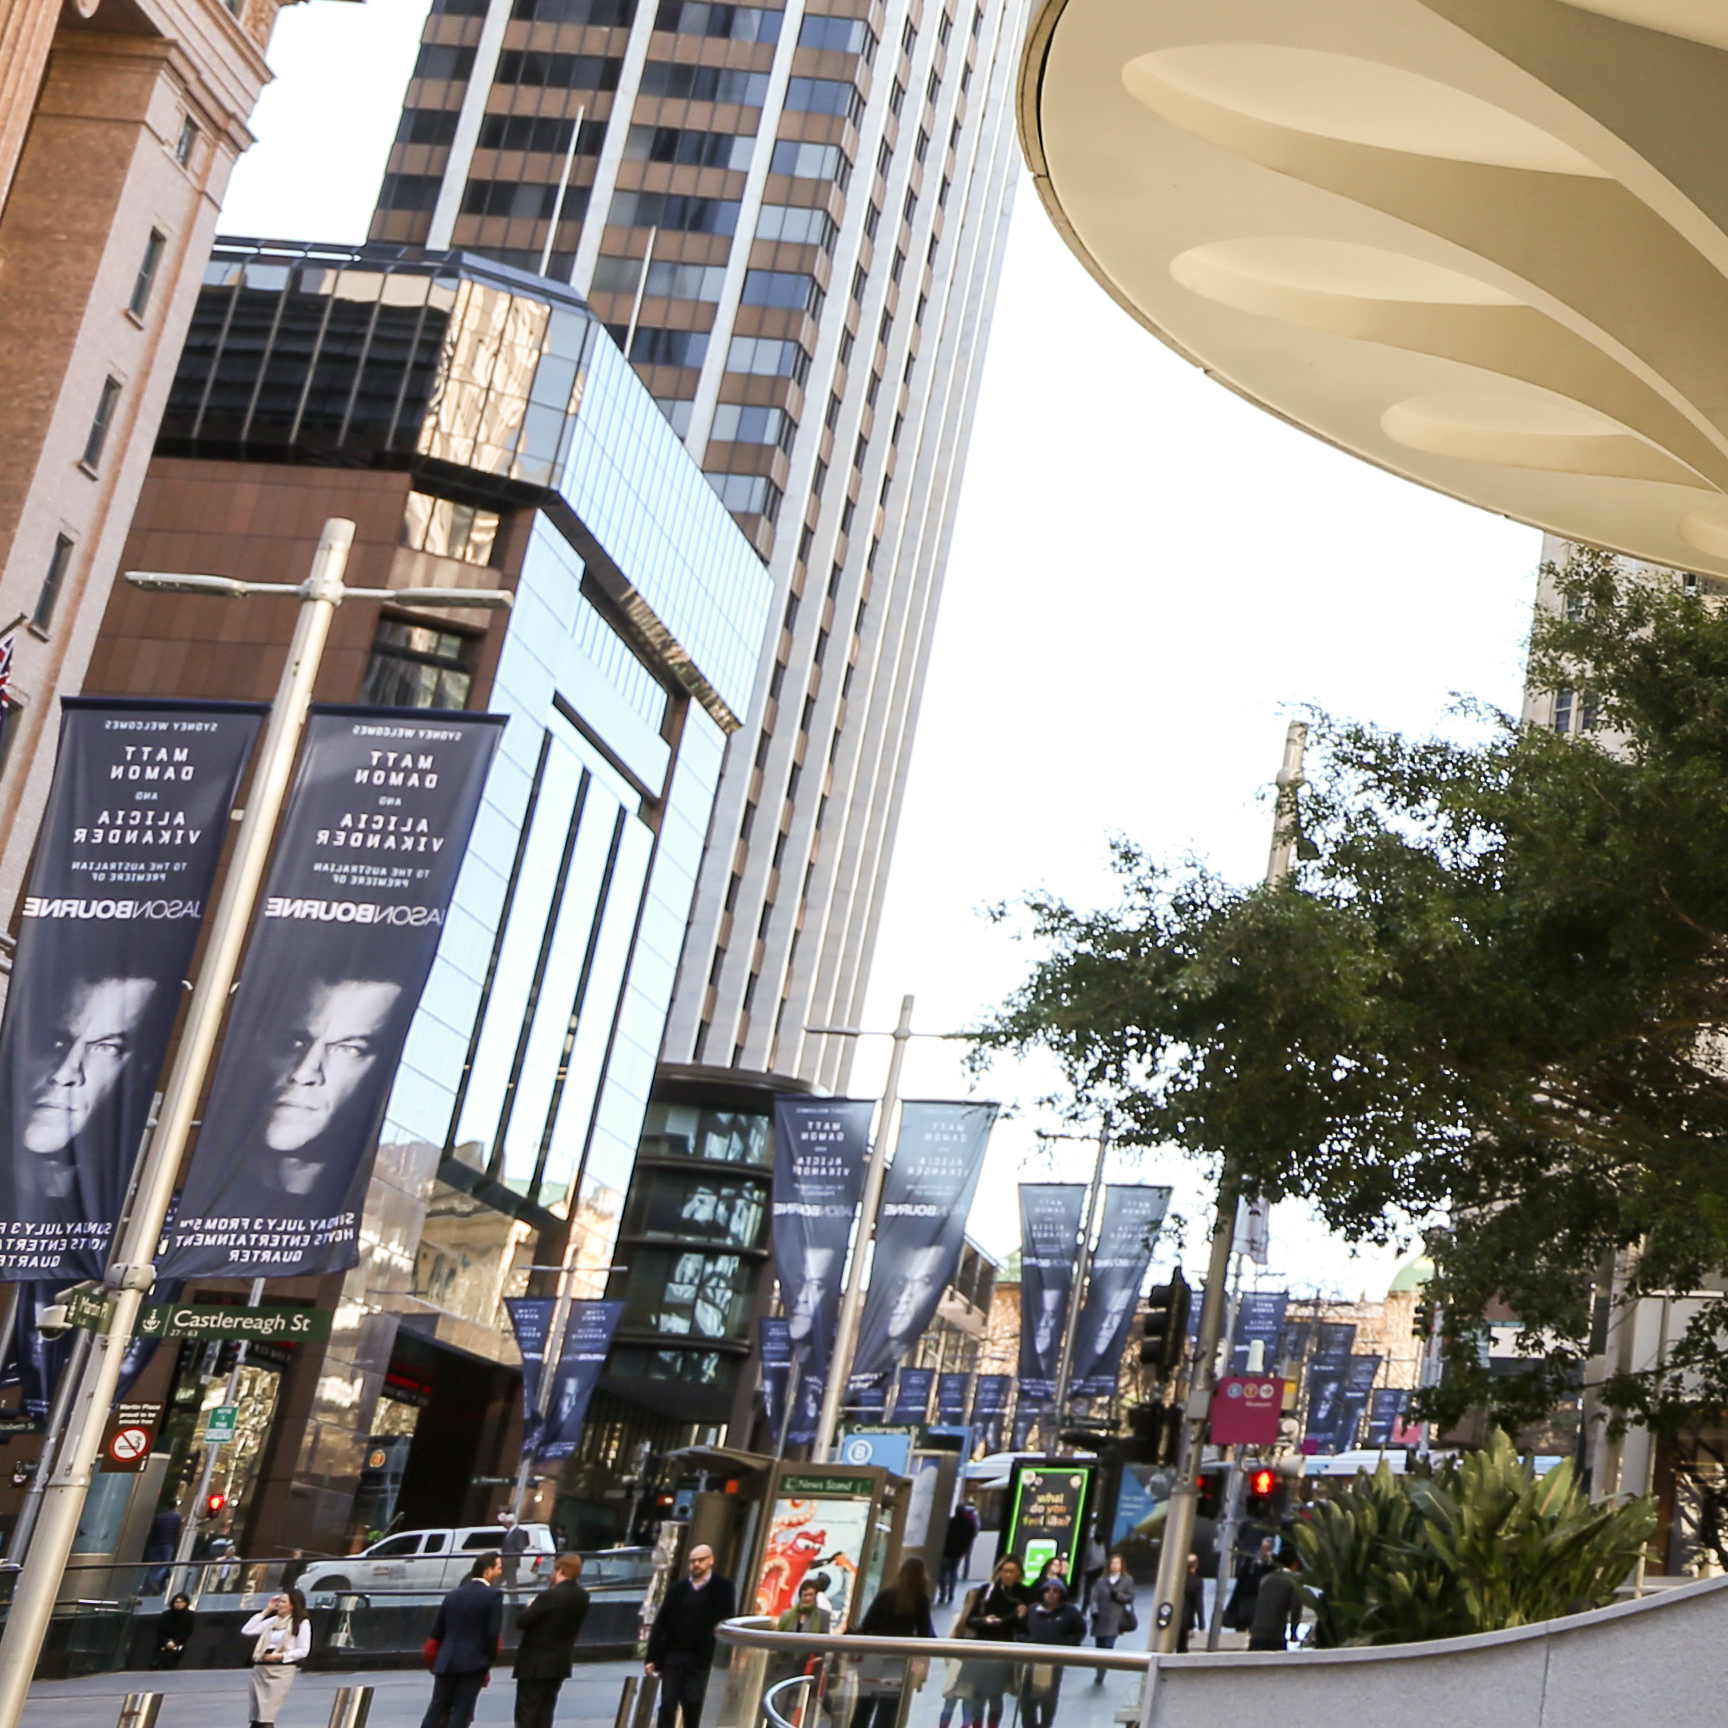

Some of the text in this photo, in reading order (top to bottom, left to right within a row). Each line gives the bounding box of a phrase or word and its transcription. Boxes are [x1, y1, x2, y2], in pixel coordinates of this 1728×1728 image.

[173, 1309, 311, 1335] Castlereagh St
[187, 1329, 198, 1337] 63
[119, 1403, 161, 1411] Martin Place
[799, 1479, 853, 1491] News Stand
